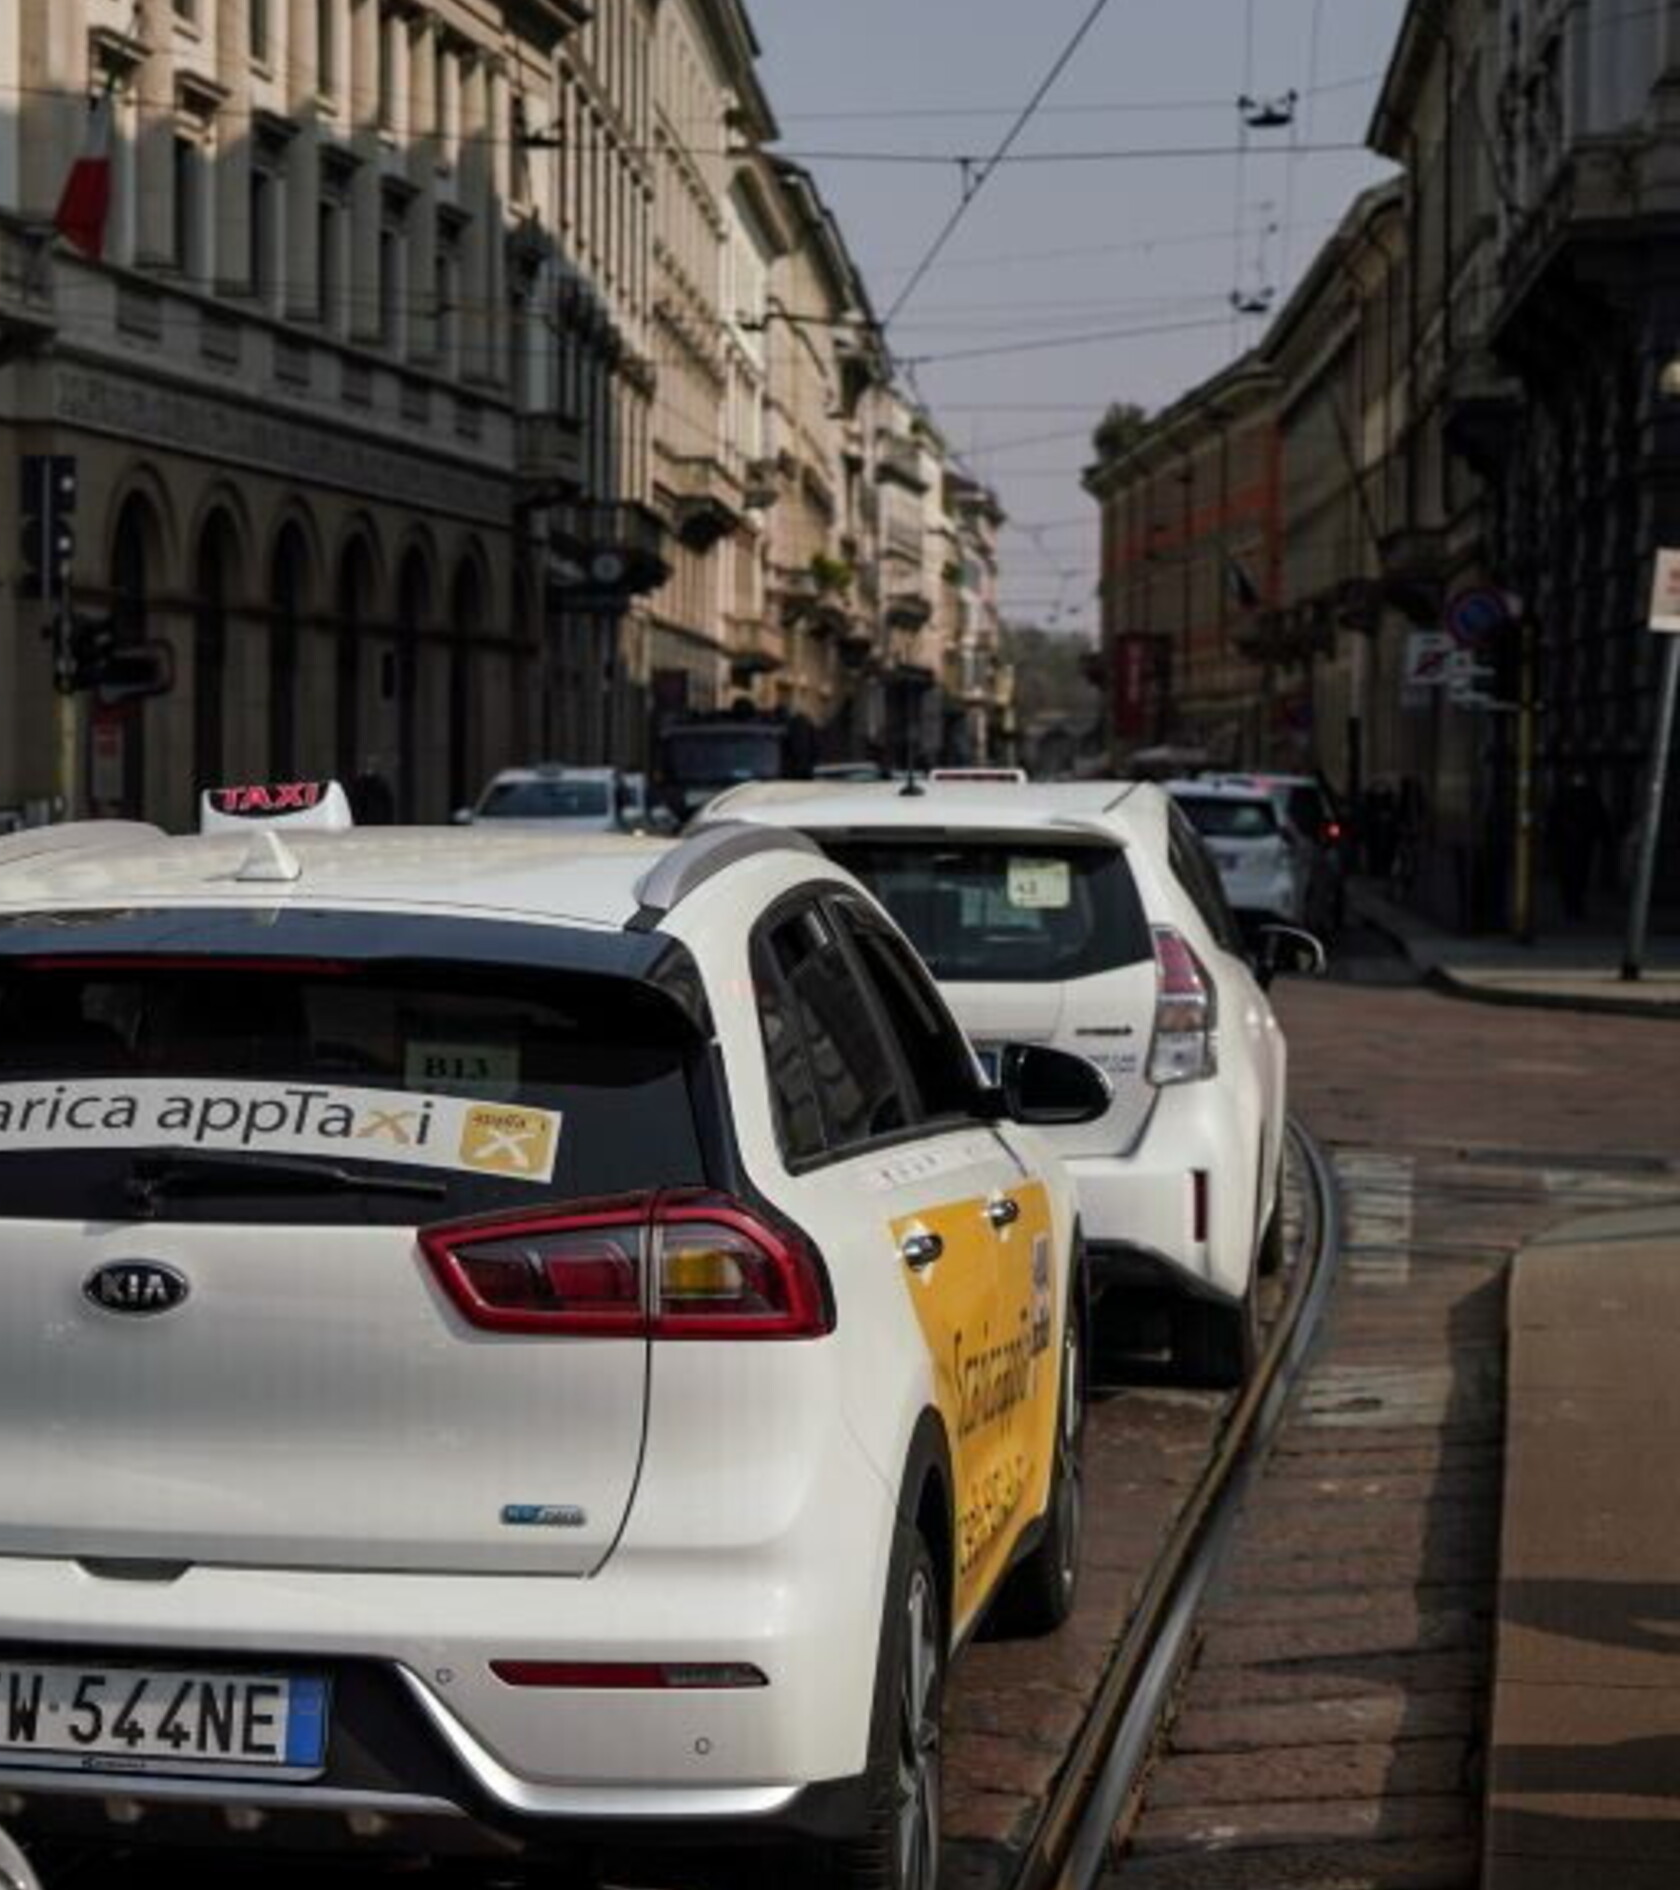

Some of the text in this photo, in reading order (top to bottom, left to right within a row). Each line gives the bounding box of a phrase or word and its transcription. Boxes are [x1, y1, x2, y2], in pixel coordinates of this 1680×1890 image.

[215, 781, 319, 810] TAXI
[424, 1056, 490, 1079] B13
[156, 1089, 434, 1145] appTaxi
[101, 1273, 170, 1303] KIA
